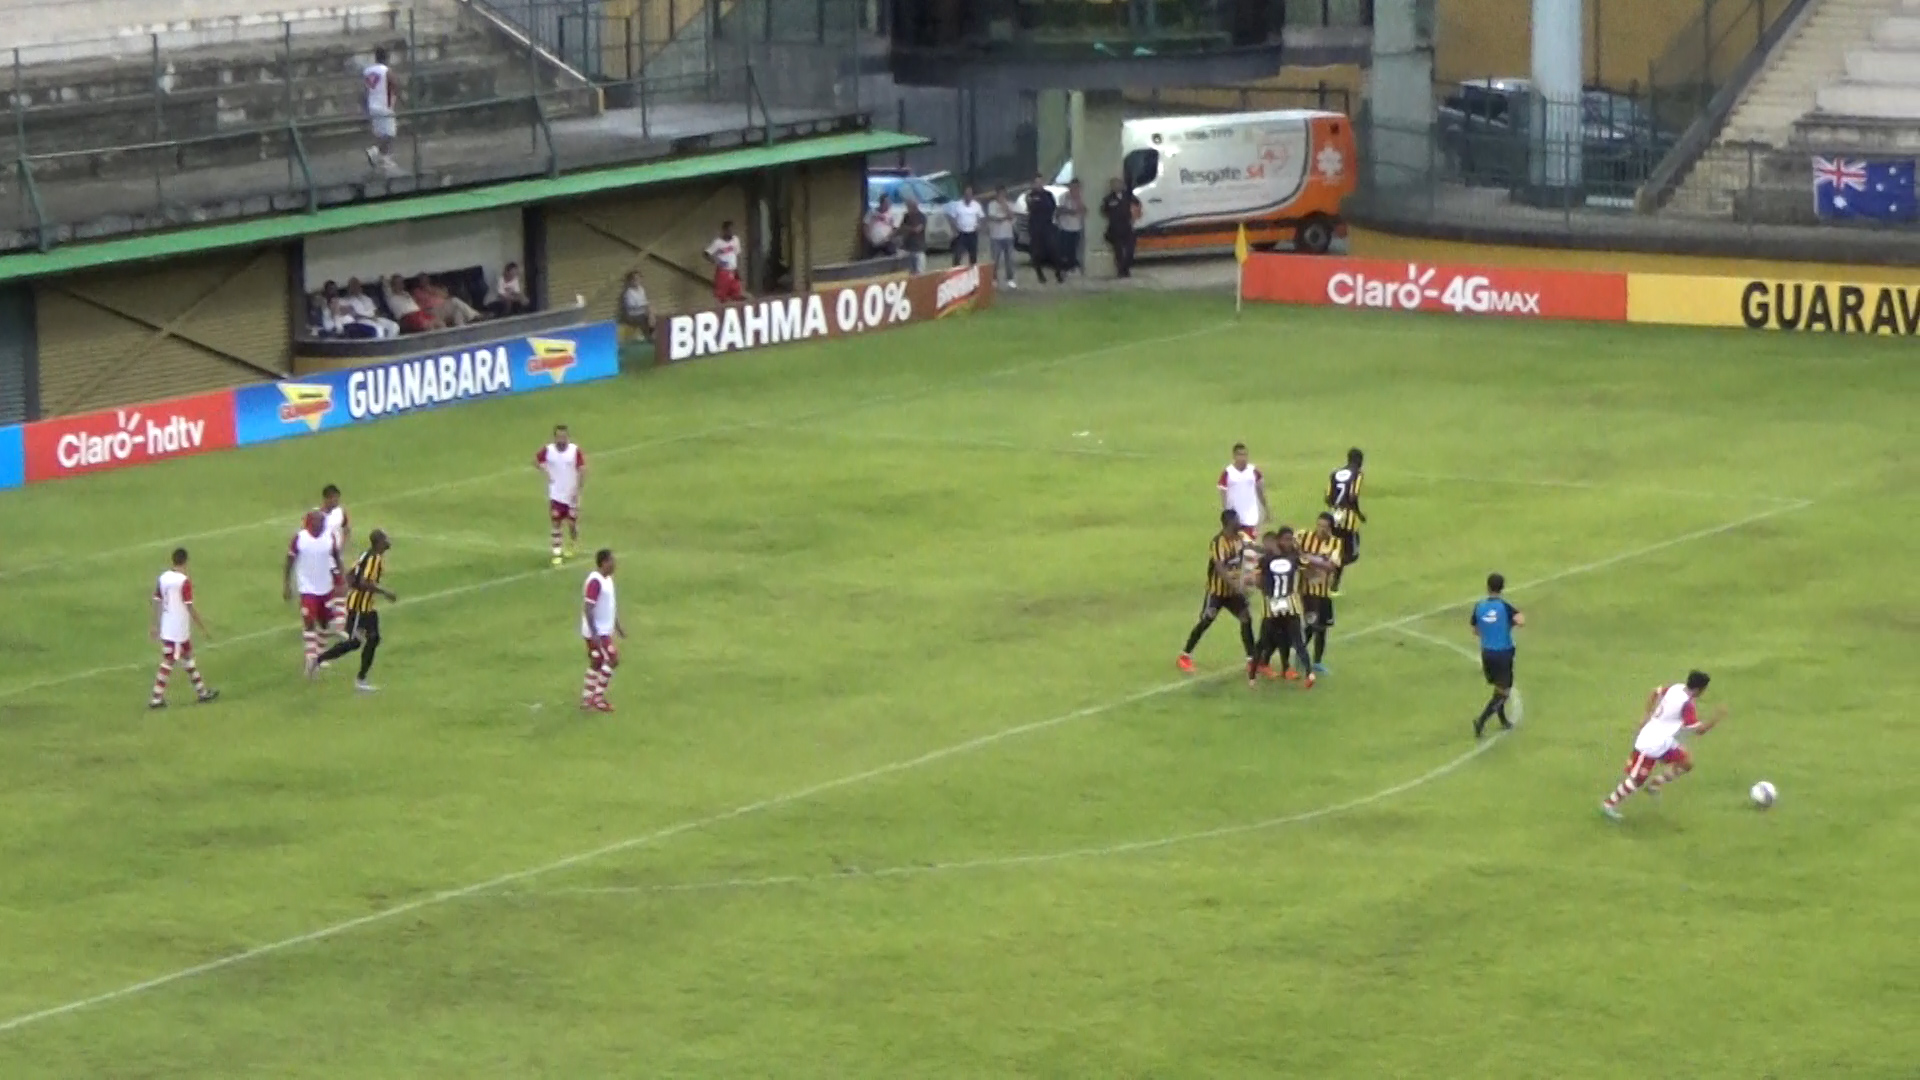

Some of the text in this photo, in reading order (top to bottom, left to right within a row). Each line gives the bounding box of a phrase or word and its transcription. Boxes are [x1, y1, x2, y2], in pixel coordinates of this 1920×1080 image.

[669, 294, 828, 361] BRAHMA
[348, 346, 512, 419] GUANABARA
[1336, 483, 1346, 505] 7
[1273, 575, 1288, 599] 11
